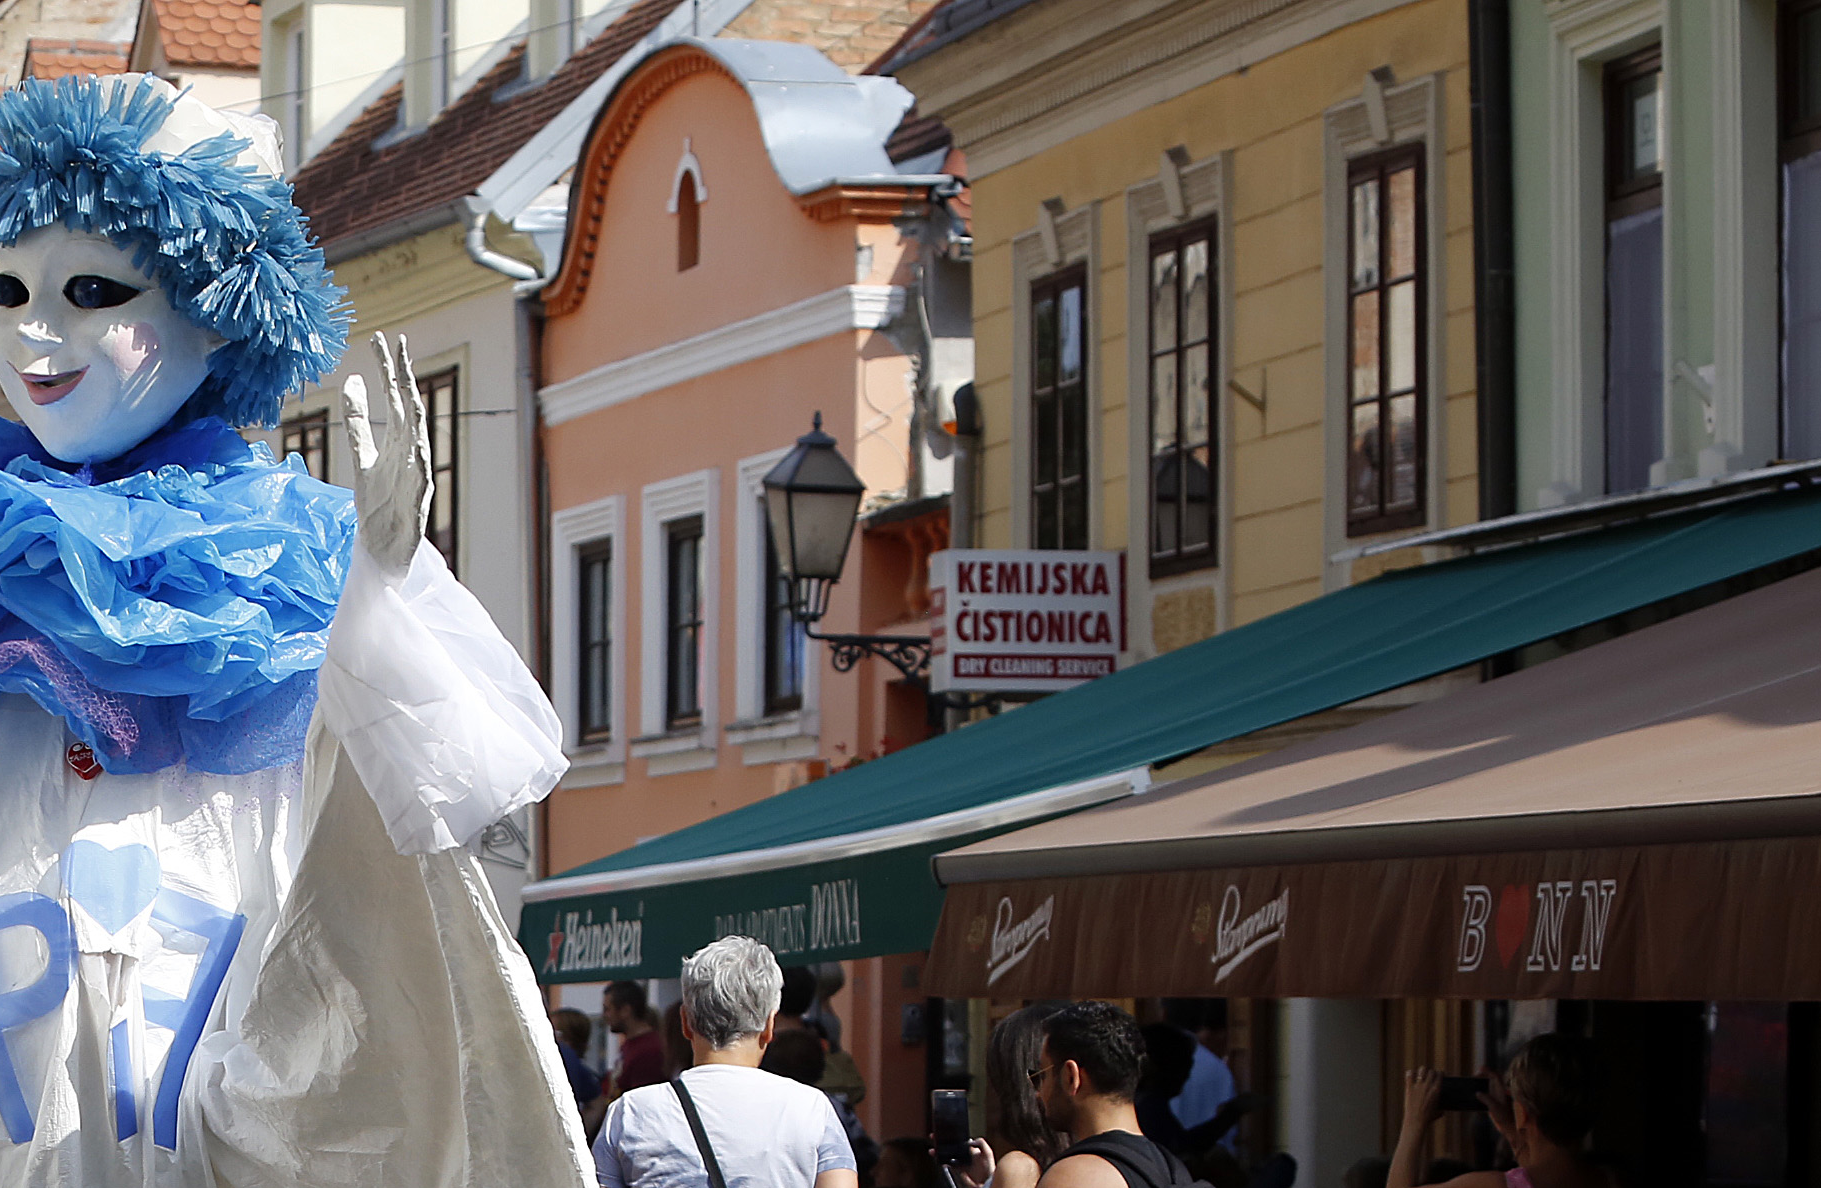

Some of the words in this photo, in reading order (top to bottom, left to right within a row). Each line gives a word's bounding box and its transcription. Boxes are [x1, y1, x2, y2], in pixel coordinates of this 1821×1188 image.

[957, 561, 1111, 595] KEMIJSKA
[956, 600, 1113, 643] ČISTIONICA
[959, 657, 986, 673] DRY
[989, 658, 1053, 674] CLEANING
[1057, 659, 1110, 675] SERVICE
[811, 878, 861, 949] DONNA
[560, 902, 643, 972] Heineken
